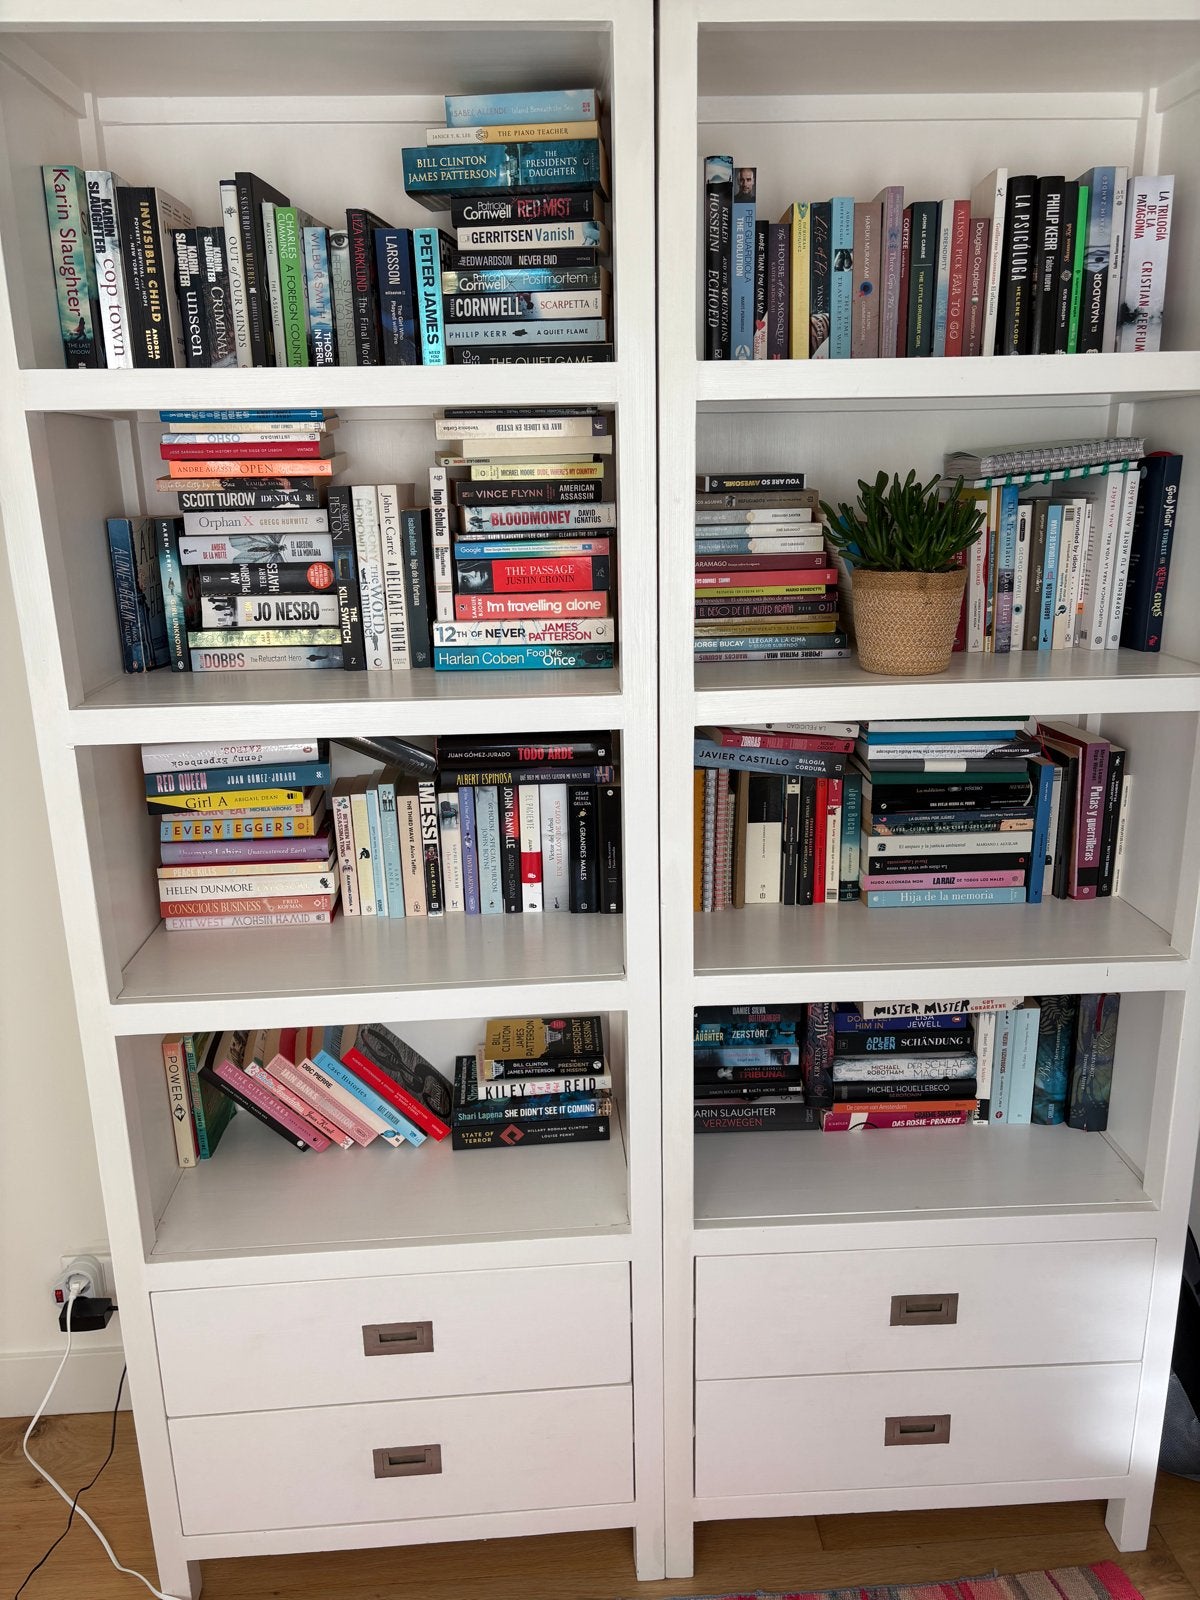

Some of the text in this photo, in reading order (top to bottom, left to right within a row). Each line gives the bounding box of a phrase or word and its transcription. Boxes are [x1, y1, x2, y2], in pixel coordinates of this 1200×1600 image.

[417, 155, 487, 169] BILL CLINTON
[526, 157, 578, 168] PRESIDENT'S
[409, 169, 497, 184] JAMES PATTERSON
[529, 167, 576, 177] DAUGHTER
[87, 181, 106, 253] SLAUGHTER
[101, 199, 116, 238] KARIN
[464, 205, 512, 220] Cornwell
[1134, 194, 1147, 239] PATAGONIA
[1156, 204, 1170, 241] TRILOGÍA
[277, 213, 287, 259] CUMMING
[285, 213, 297, 259] CHARLES
[471, 227, 575, 243] GERRITSEN Vanish
[1011, 195, 1033, 280] LA PSICÓLOGA
[1044, 193, 1060, 272] PHILIP KERR Falso
[52, 168, 83, 316] Karin Slaughter
[140, 202, 162, 323] INVISIBLE CHILD
[385, 236, 401, 284] LARSSON
[466, 254, 558, 266] EDWARDSON NEVER END
[708, 193, 720, 327] HOSSEINI ECHOED
[971, 222, 984, 296] Douglas Coupland
[310, 233, 326, 319] WILBUR SMITH
[523, 273, 588, 284] Postmortem
[1139, 261, 1153, 307] CRISTIAN
[228, 236, 247, 348] OUT of OUR MINDS
[420, 234, 439, 345] PETER JAMES
[1091, 273, 1103, 323] NADADOR
[101, 259, 126, 356] cop town
[354, 238, 371, 365] MARKLUND The Final Word
[455, 296, 590, 317] CORNWELL SCARPETTA
[186, 291, 203, 357] unseen
[211, 286, 229, 358] CRIMINAL
[151, 328, 161, 360] ANDREA
[449, 331, 479, 339] PHILIP
[145, 330, 154, 360] ELLIOTT
[314, 329, 325, 367] IN PERIL
[323, 332, 333, 363] THOSE
[773, 474, 801, 484] YOU ARE
[183, 492, 255, 508] SCOTT TUROW
[476, 489, 542, 498] VINCE FLYNN
[330, 496, 343, 540] PESTON
[432, 488, 447, 536] Ingo Schulze
[491, 510, 570, 527] BLOODMONEY
[199, 515, 254, 530] Orphan X
[268, 563, 280, 592] HAYES
[504, 565, 575, 576] THE PASSAGE
[1152, 566, 1167, 617] REBEL GIRLS
[254, 601, 319, 621] JO NESBO
[339, 586, 352, 643] KILL SWITCH
[387, 570, 406, 651] DELICATE TRUTH
[487, 598, 601, 613] I'm travelling alone
[1044, 600, 1053, 619] GABRIEL
[485, 628, 526, 639] NEVER
[528, 631, 592, 641] PATTERSON
[542, 623, 578, 631] JAMES
[526, 648, 562, 657] Fool Me
[720, 640, 744, 648] BUCAY
[205, 653, 245, 669] DOBBS
[439, 652, 524, 665] Harlan Coben
[543, 656, 575, 666] Once
[518, 746, 572, 760] TODO ARDE
[699, 750, 789, 766] JAVIER CASTILLO
[457, 773, 512, 785] ALBERT ESPINOSA
[185, 796, 228, 809] Girl A
[847, 788, 858, 834] Jorge Bucay
[419, 787, 438, 844] MESSI
[503, 786, 516, 848] JOHN BANVILLE
[1083, 786, 1103, 861] Putas guerrilleras
[175, 822, 292, 836] EVERY EGGERS
[165, 883, 254, 895] HELEN DUNMORE
[900, 890, 993, 903] Hija memoria
[168, 900, 260, 915] CONSCIOUS BUSINESS
[231, 913, 310, 926] MOHSIN HAMID
[873, 999, 969, 1016] MISTER MISTER
[907, 1020, 941, 1028] JEWELL
[731, 1029, 769, 1039] ZERSTÖRT
[900, 1036, 964, 1046] SCHÄNDUNG
[168, 1055, 183, 1102] POWER
[326, 1062, 368, 1098] Case Histories
[485, 1078, 596, 1100] KILEY REID
[867, 1084, 950, 1093] MICHEL HOUELLEBECQ
[458, 1110, 503, 1120] Shari Lapena
[504, 1104, 595, 1118] SHE DIDN'T SEE COMING
[720, 1107, 776, 1117] SLAUGHTER
[703, 1119, 763, 1127] VERZWEGEN
